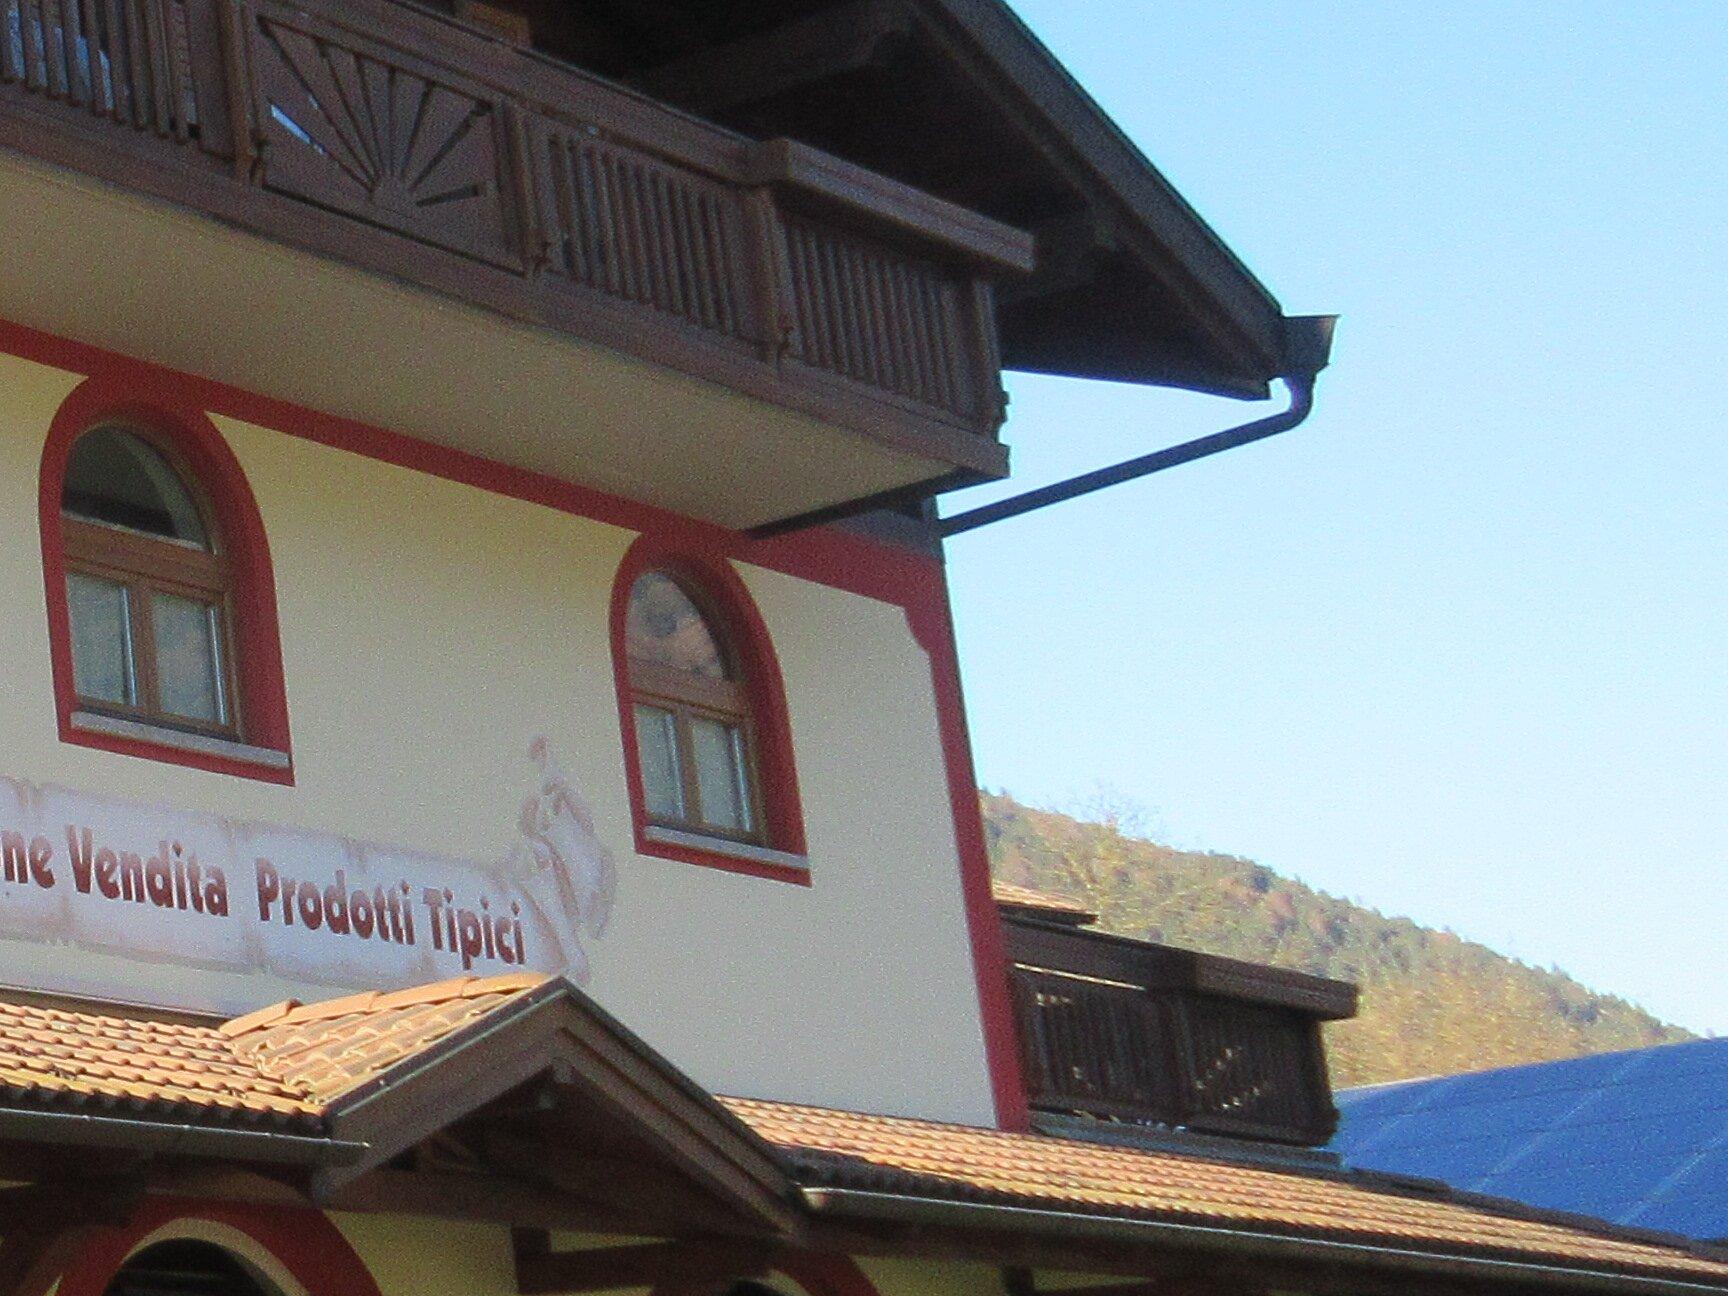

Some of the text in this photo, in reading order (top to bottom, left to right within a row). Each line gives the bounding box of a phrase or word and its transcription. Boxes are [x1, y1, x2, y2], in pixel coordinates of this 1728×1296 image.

[65, 824, 229, 917] Vendita
[255, 857, 416, 946] Prodotti
[423, 886, 526, 970] Tipici
